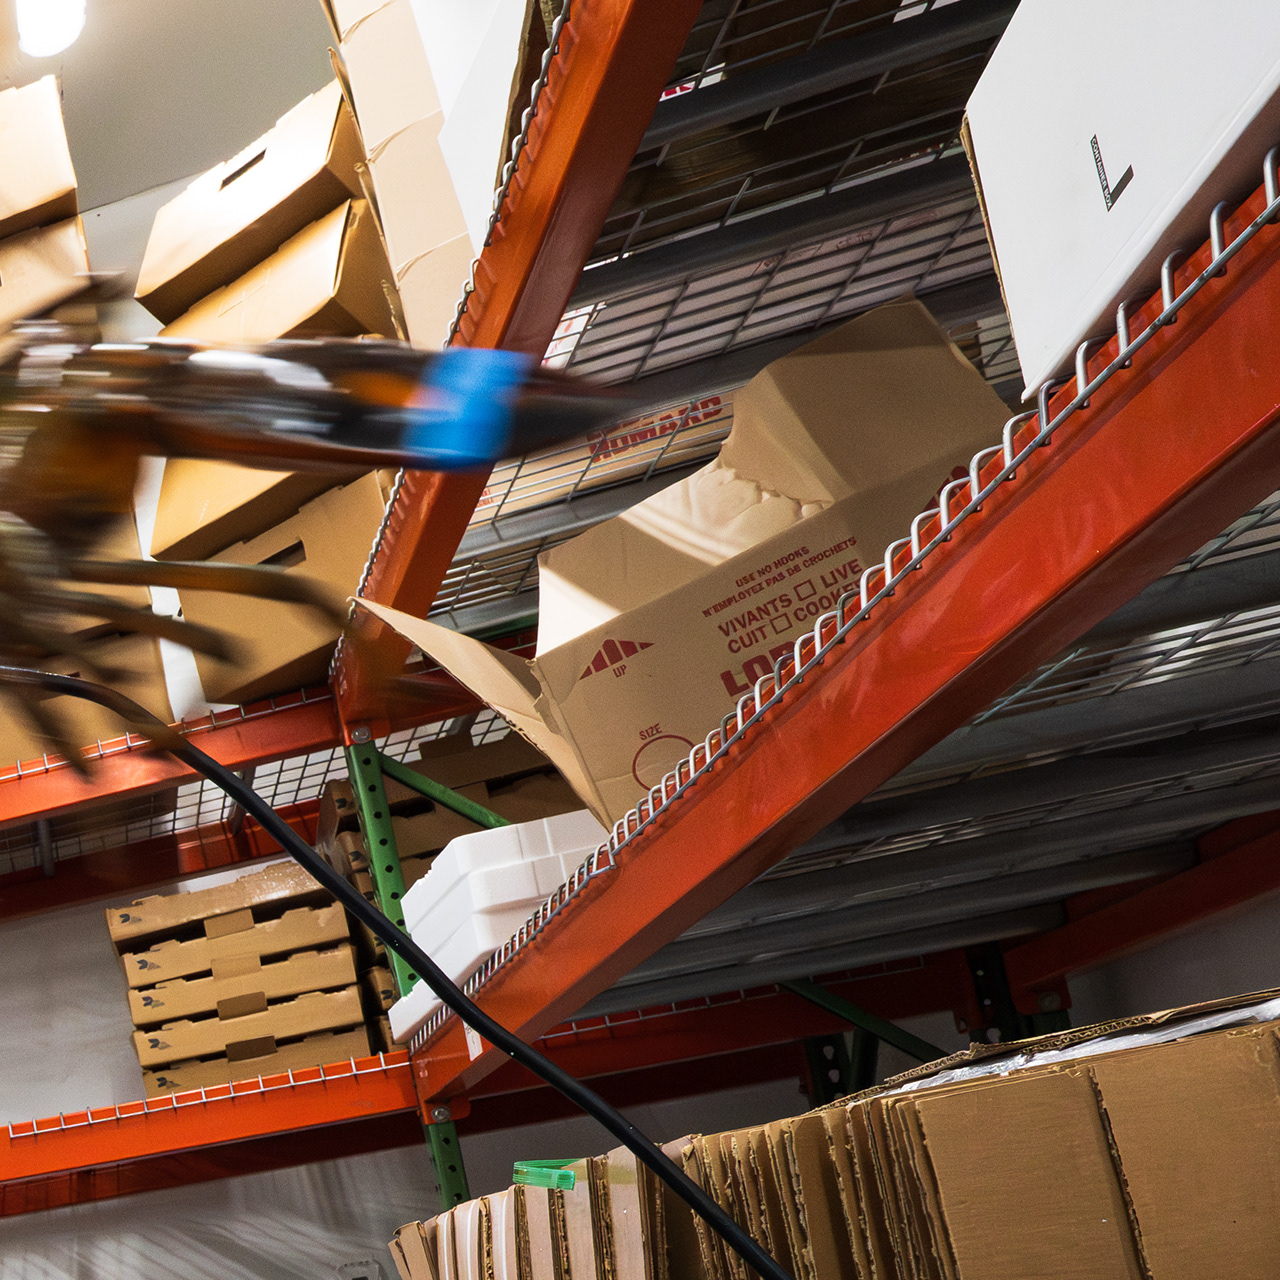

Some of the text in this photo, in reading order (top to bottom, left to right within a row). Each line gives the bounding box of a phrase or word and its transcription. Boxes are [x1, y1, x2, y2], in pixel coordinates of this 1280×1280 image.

[1104, 187, 1113, 210] BOX
[736, 546, 810, 588] USE NO HOOKS
[765, 571, 787, 587] PAS
[786, 564, 802, 577] DE
[803, 536, 857, 568] CROCHETS
[718, 558, 863, 637] VIVANTS LIVE
[728, 622, 770, 654] CUIT
[612, 664, 628, 678] UP
[639, 723, 663, 741] SIZE
